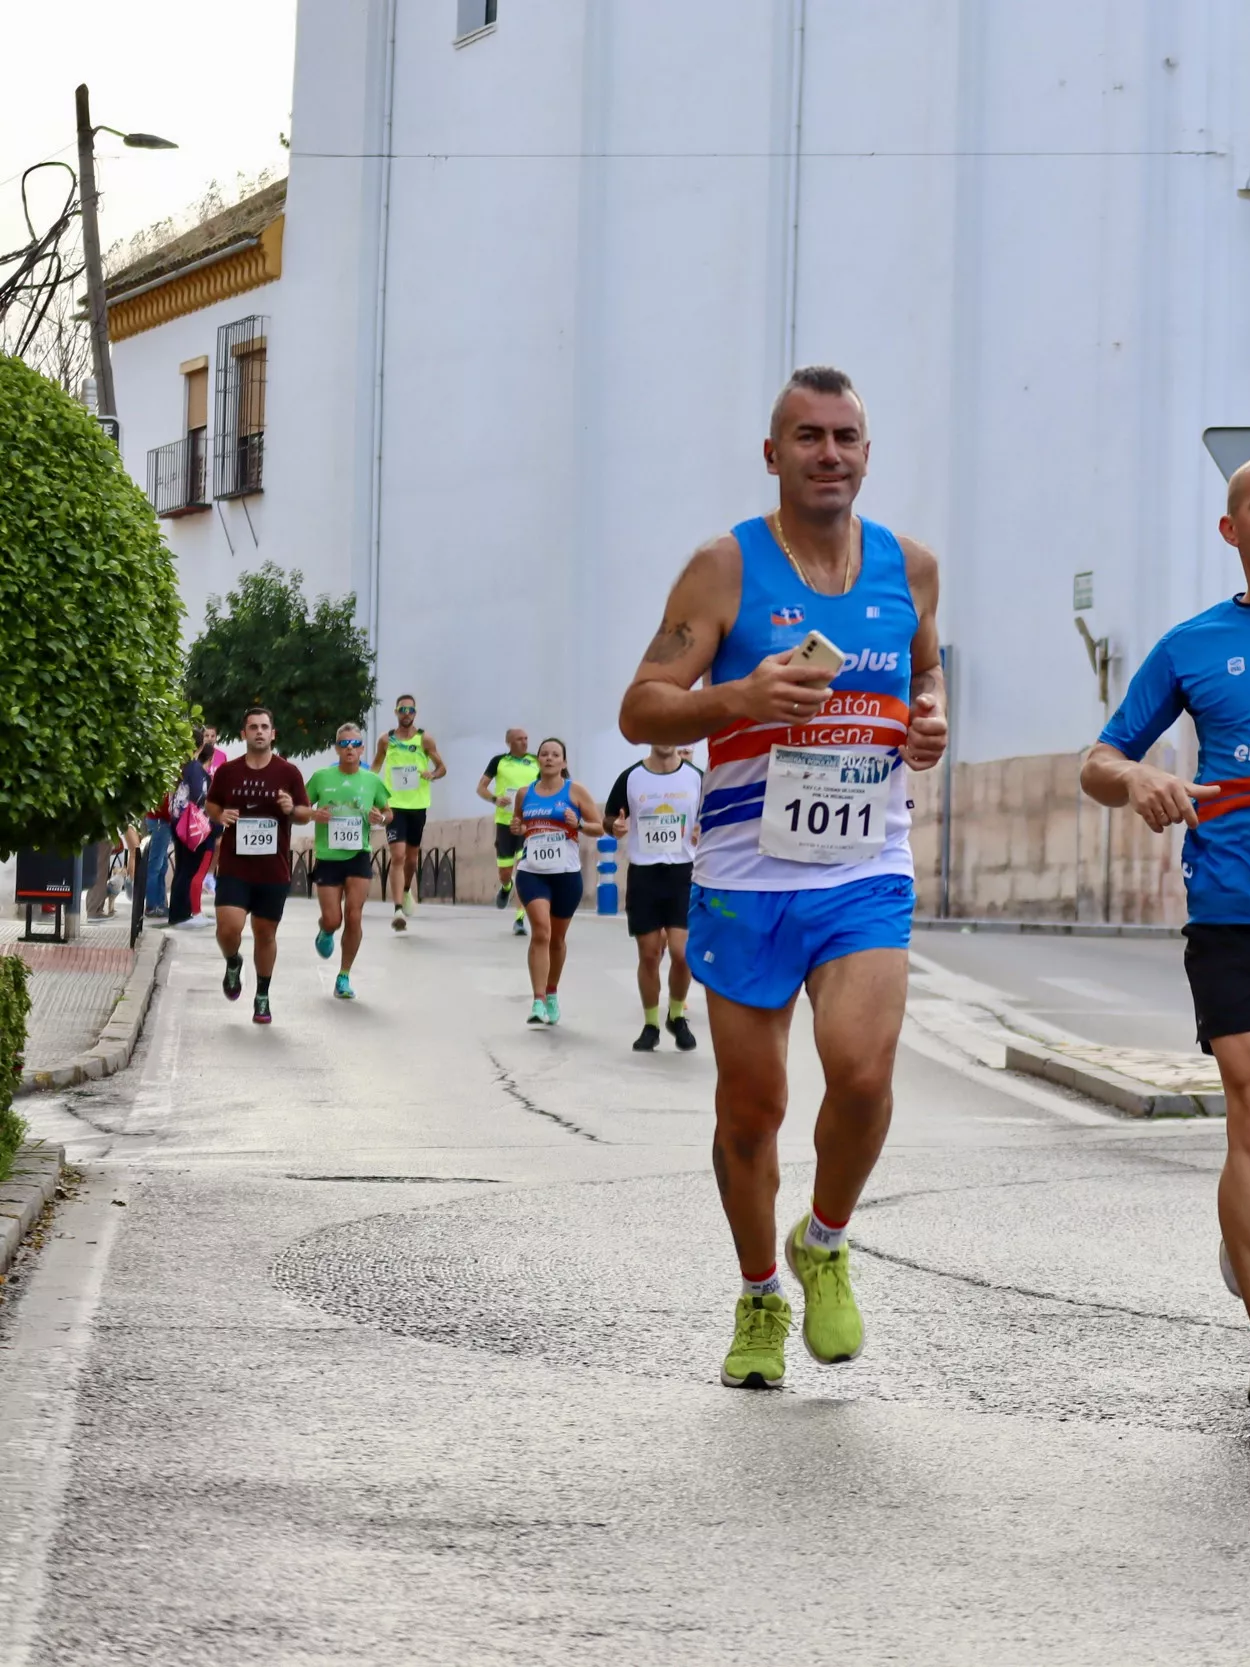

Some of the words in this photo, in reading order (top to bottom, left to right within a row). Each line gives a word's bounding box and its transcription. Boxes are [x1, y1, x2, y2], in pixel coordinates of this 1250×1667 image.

[835, 648, 899, 677] plus
[820, 694, 881, 717] ratón
[787, 727, 874, 746] Lucena
[402, 776, 408, 785] 3
[232, 789, 276, 797] RUNNING
[785, 799, 871, 837] 1011
[242, 834, 273, 846] 1299
[333, 831, 360, 841] 1305
[645, 830, 677, 843] 1409
[533, 847, 561, 860] 1001
